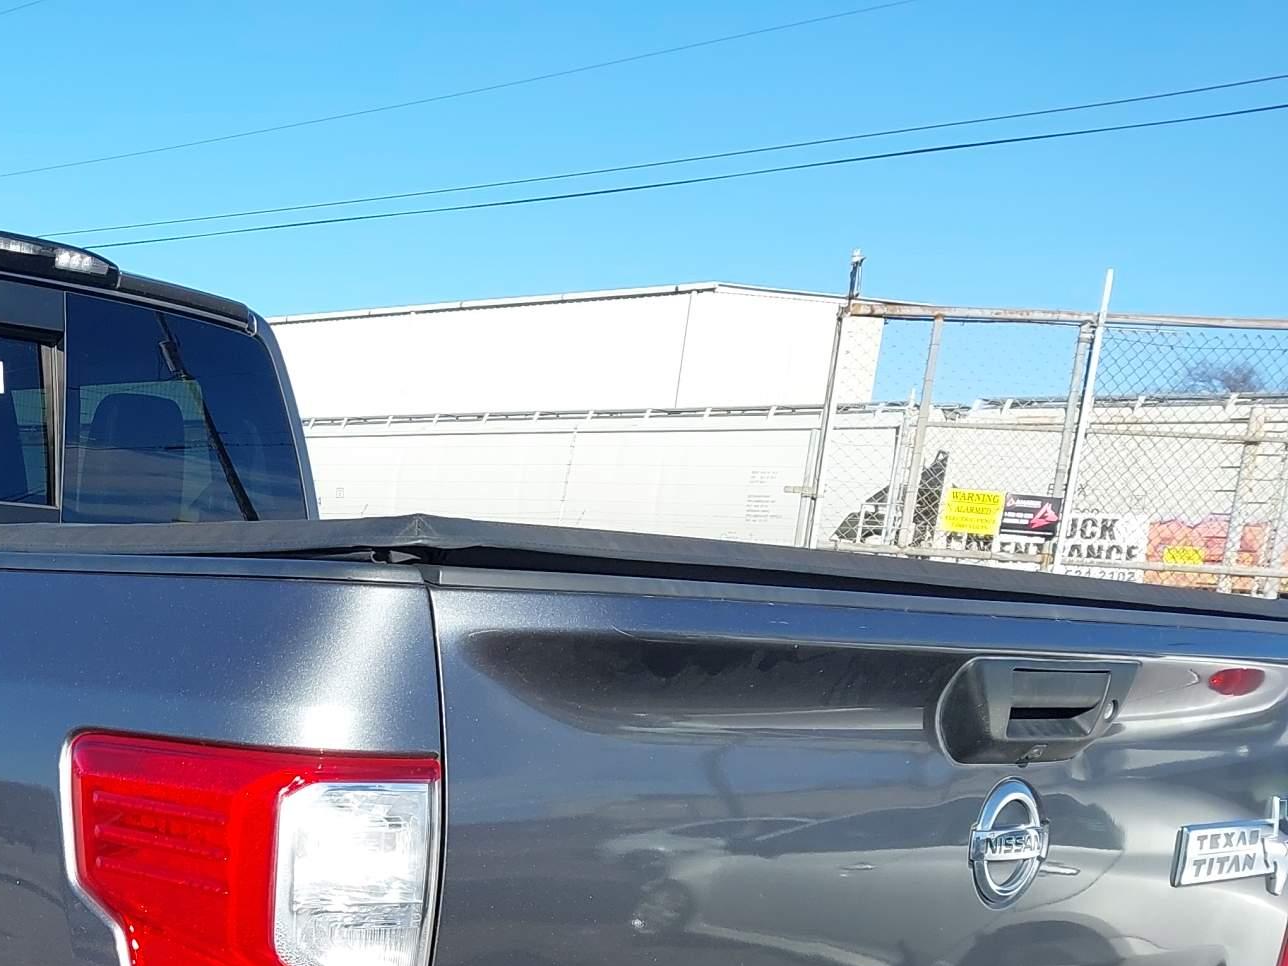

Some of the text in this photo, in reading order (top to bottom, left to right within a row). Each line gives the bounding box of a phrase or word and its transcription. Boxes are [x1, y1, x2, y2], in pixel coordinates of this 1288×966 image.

[952, 491, 1000, 504] WARNING
[954, 505, 992, 515] ALARMED
[984, 834, 1041, 854] NISSAN
[1196, 829, 1260, 850] TEXAS
[1193, 852, 1257, 877] TITAN
